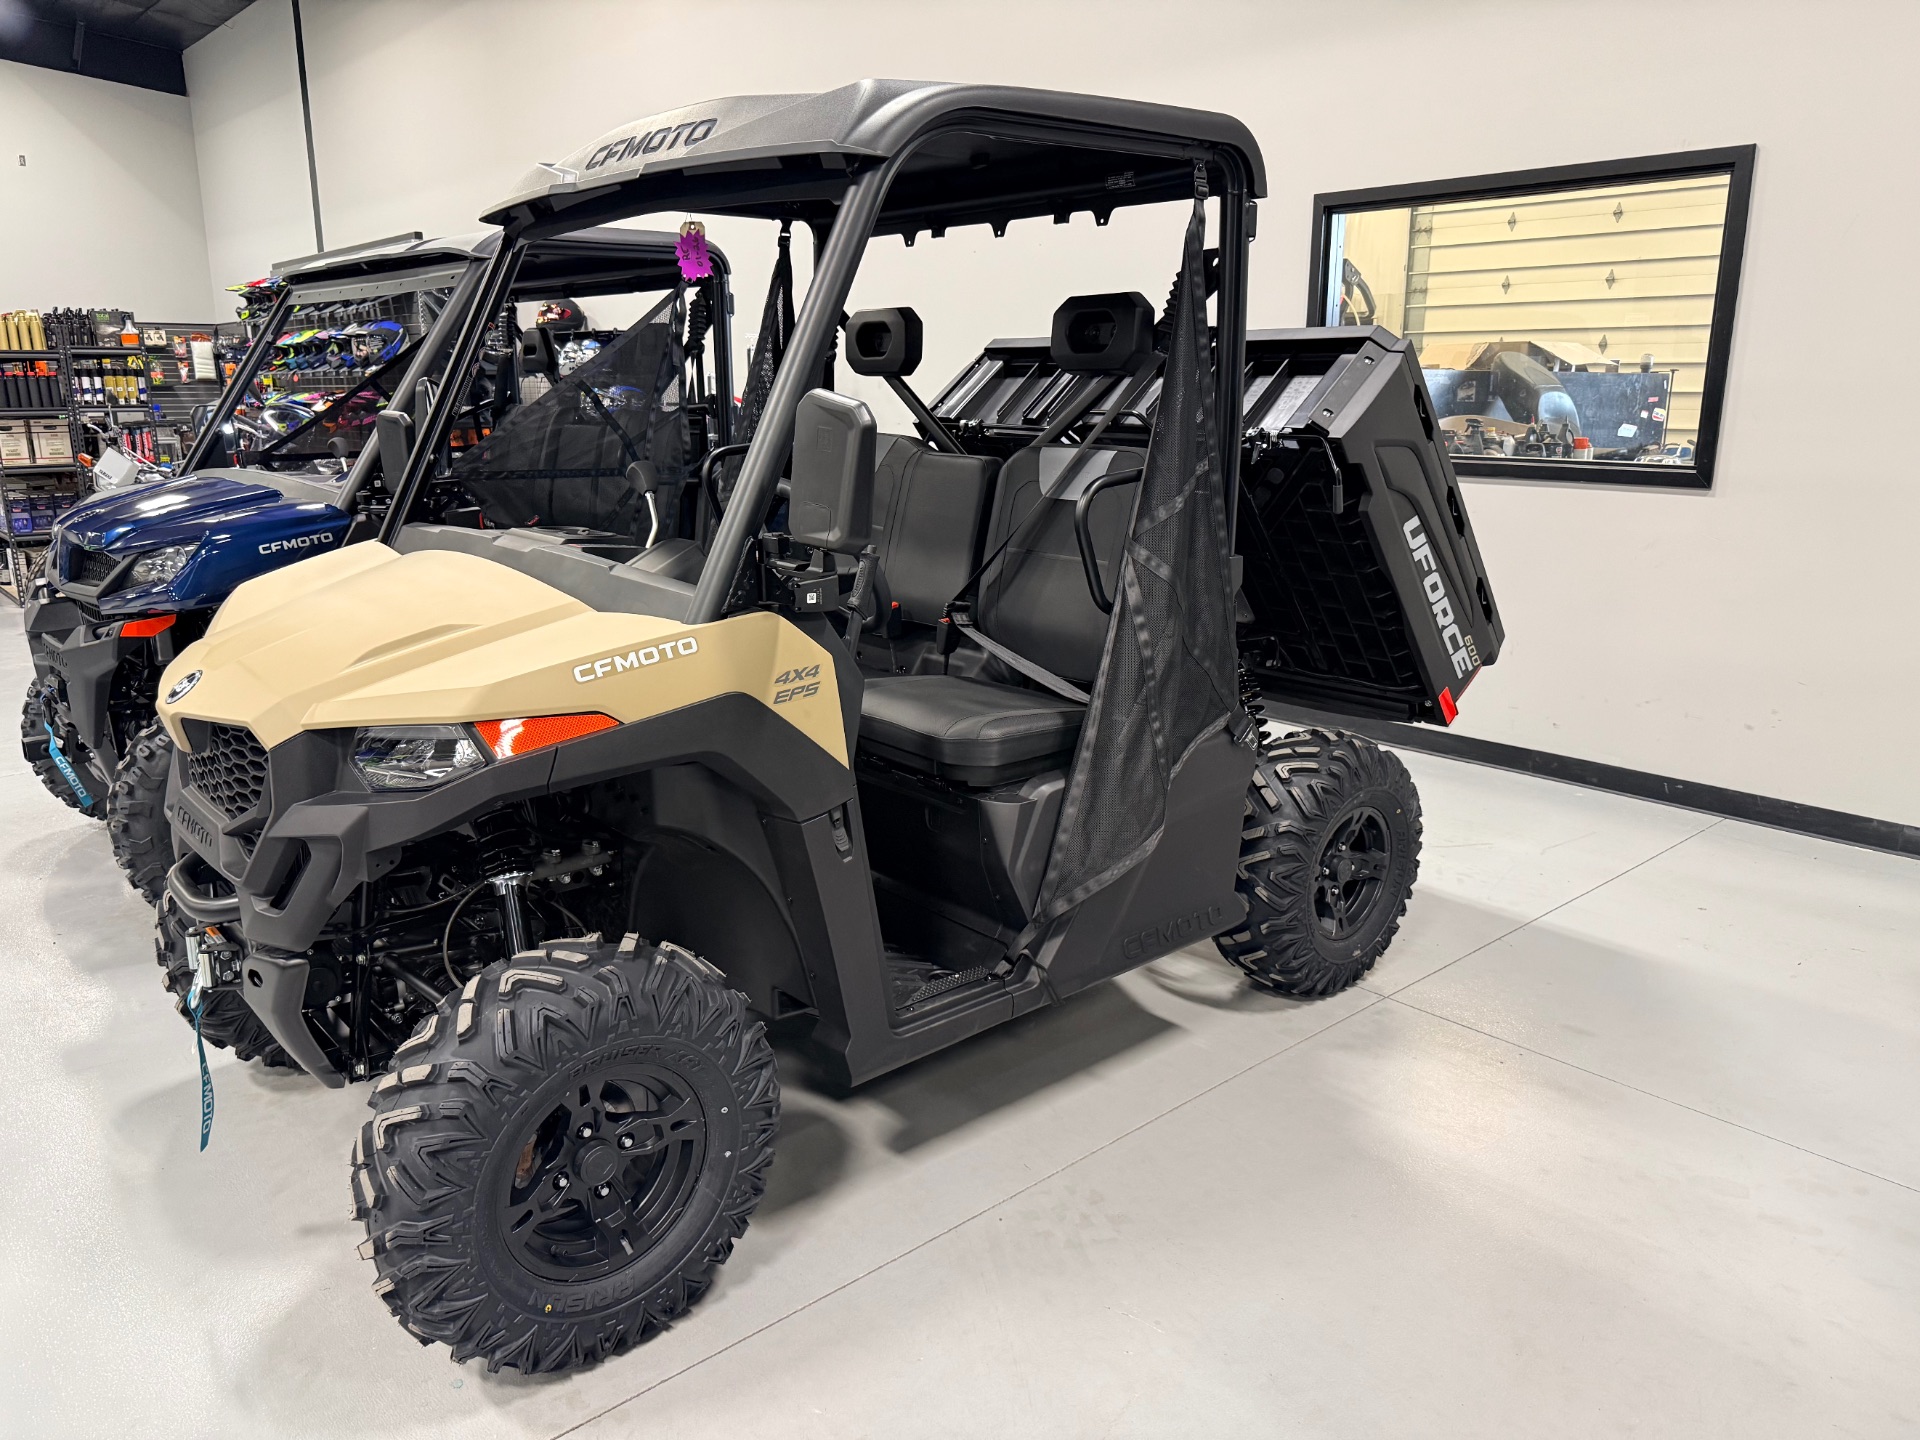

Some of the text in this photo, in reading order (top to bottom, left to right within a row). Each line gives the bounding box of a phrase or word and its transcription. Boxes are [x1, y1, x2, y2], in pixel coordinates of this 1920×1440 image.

[585, 117, 718, 172] CFMOTO
[258, 531, 334, 556] CFMOTO
[1402, 514, 1474, 680] UFORCE
[573, 636, 699, 684] CFMOTO
[1463, 634, 1482, 667] 600
[773, 681, 821, 705] EPS
[774, 664, 821, 685] 4X4
[55, 755, 87, 798] CFMOTO
[1122, 905, 1223, 960] CFMOTO
[201, 1061, 214, 1135] CFMOTO
